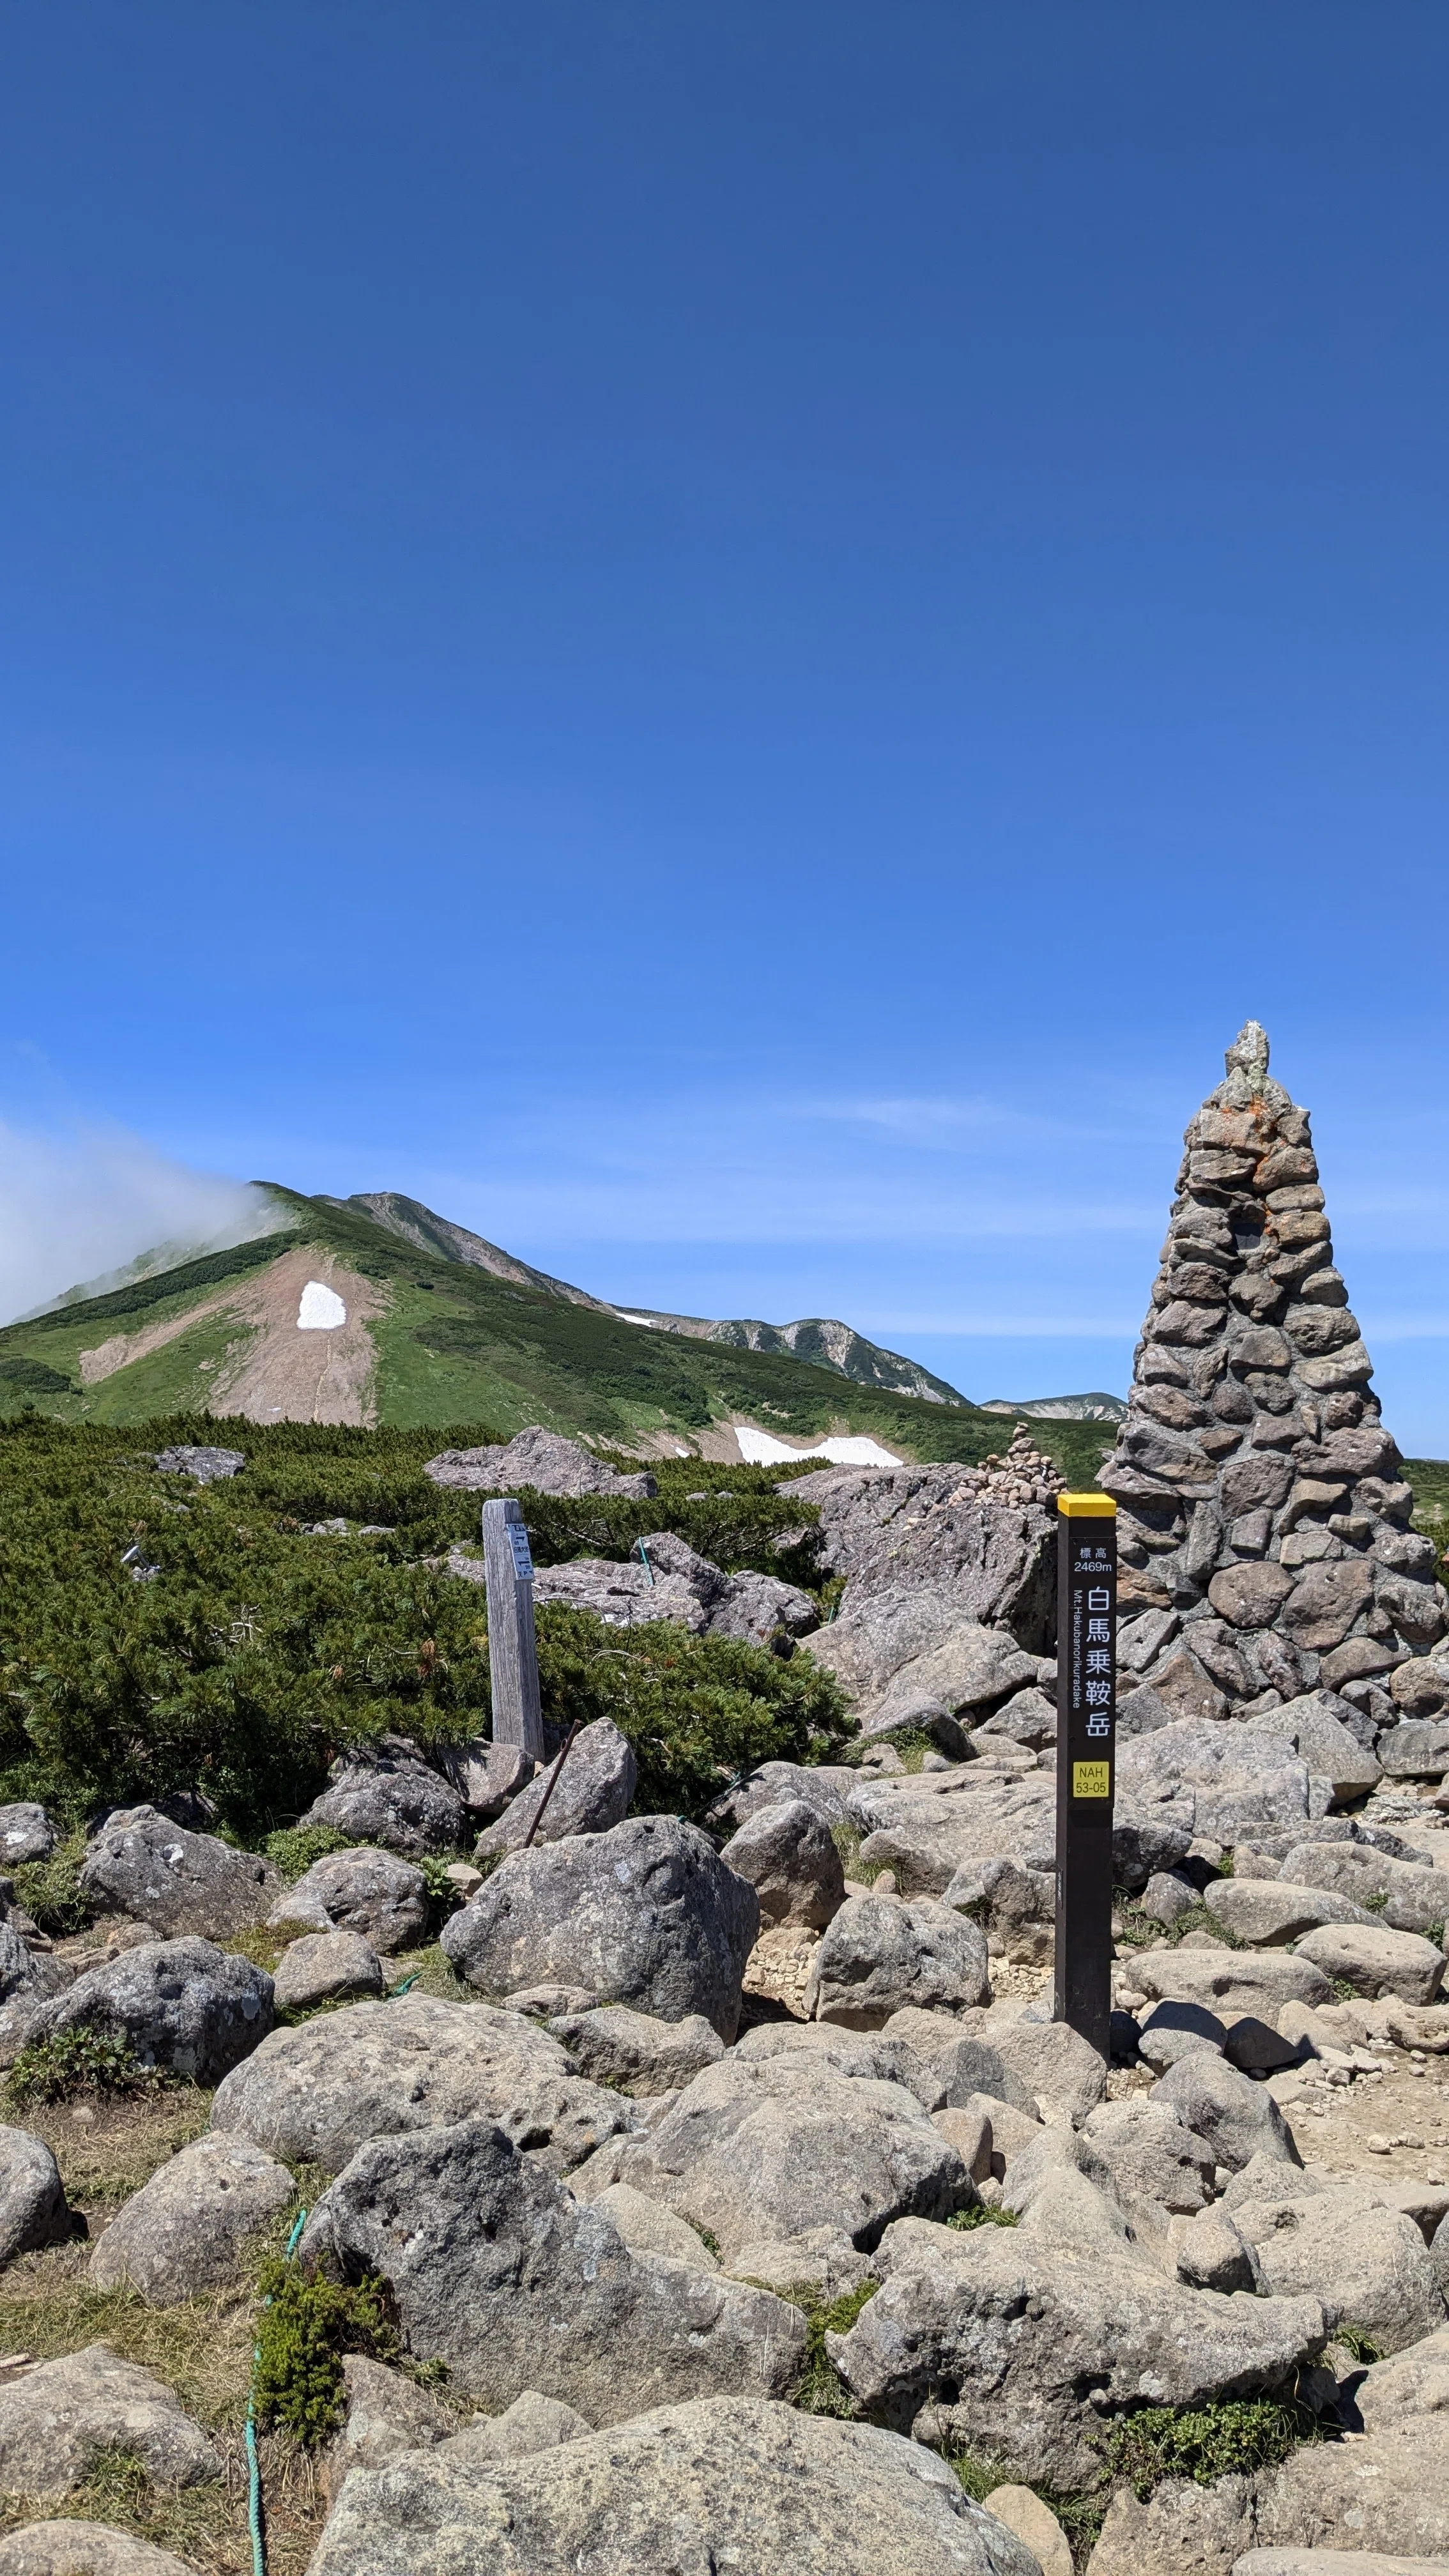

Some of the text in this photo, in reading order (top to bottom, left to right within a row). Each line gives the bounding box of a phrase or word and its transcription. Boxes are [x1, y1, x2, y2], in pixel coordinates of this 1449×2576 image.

[1080, 1547, 1107, 1559] 標高
[1074, 1561, 1112, 1572] 2469m
[1085, 1586, 1111, 1736] 白馬乗鞍岳
[1079, 1767, 1103, 1778] NAH
[1076, 1782, 1106, 1793] 53-05
